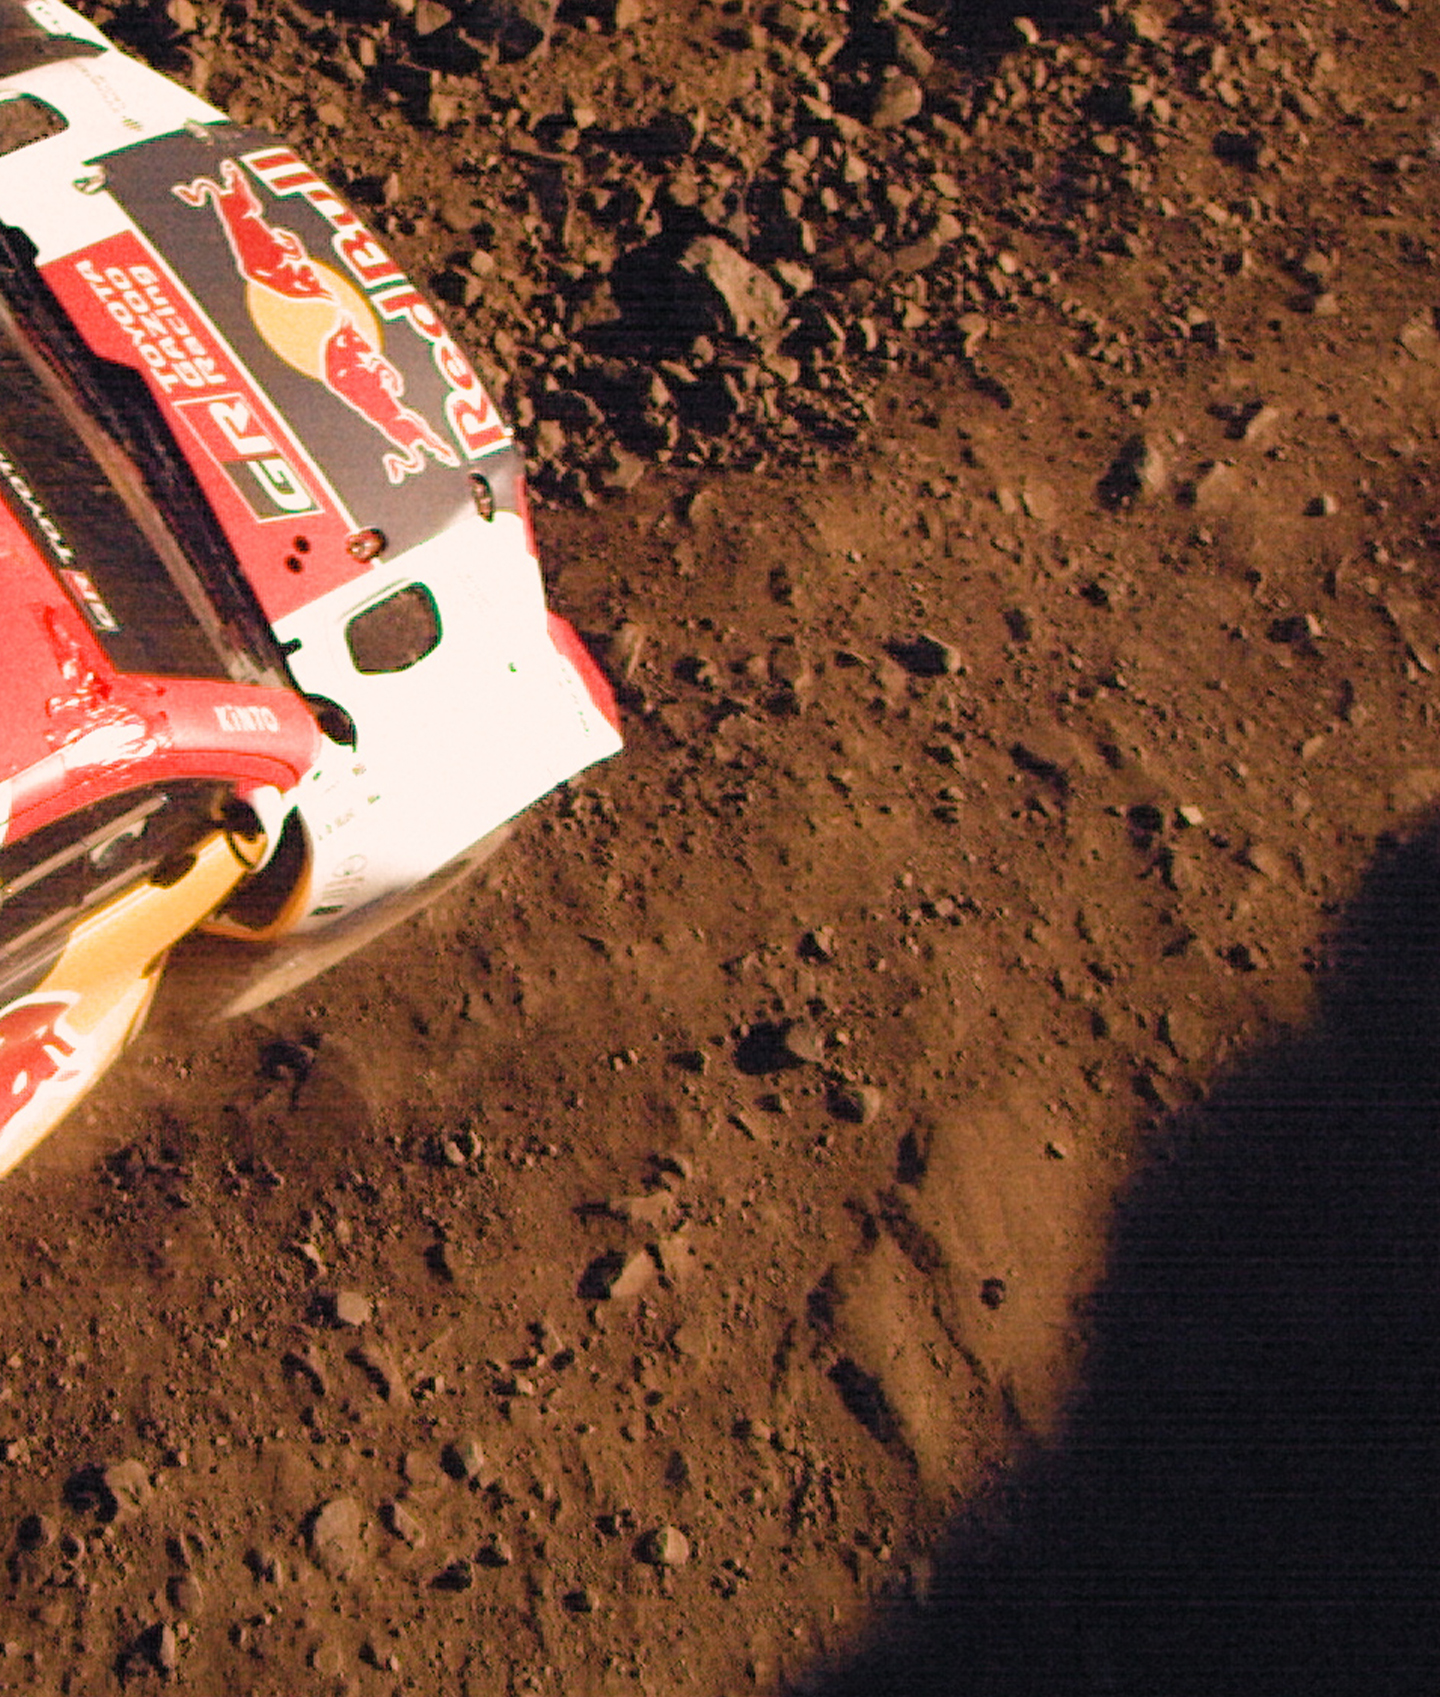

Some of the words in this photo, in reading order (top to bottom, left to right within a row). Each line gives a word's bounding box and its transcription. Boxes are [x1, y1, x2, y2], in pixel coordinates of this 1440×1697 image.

[240, 147, 407, 289] Bull
[74, 259, 180, 394] TOYOTA
[104, 266, 206, 388] GAZOO
[129, 265, 227, 385] Racing
[370, 283, 514, 460] Red
[207, 400, 314, 513] GR
